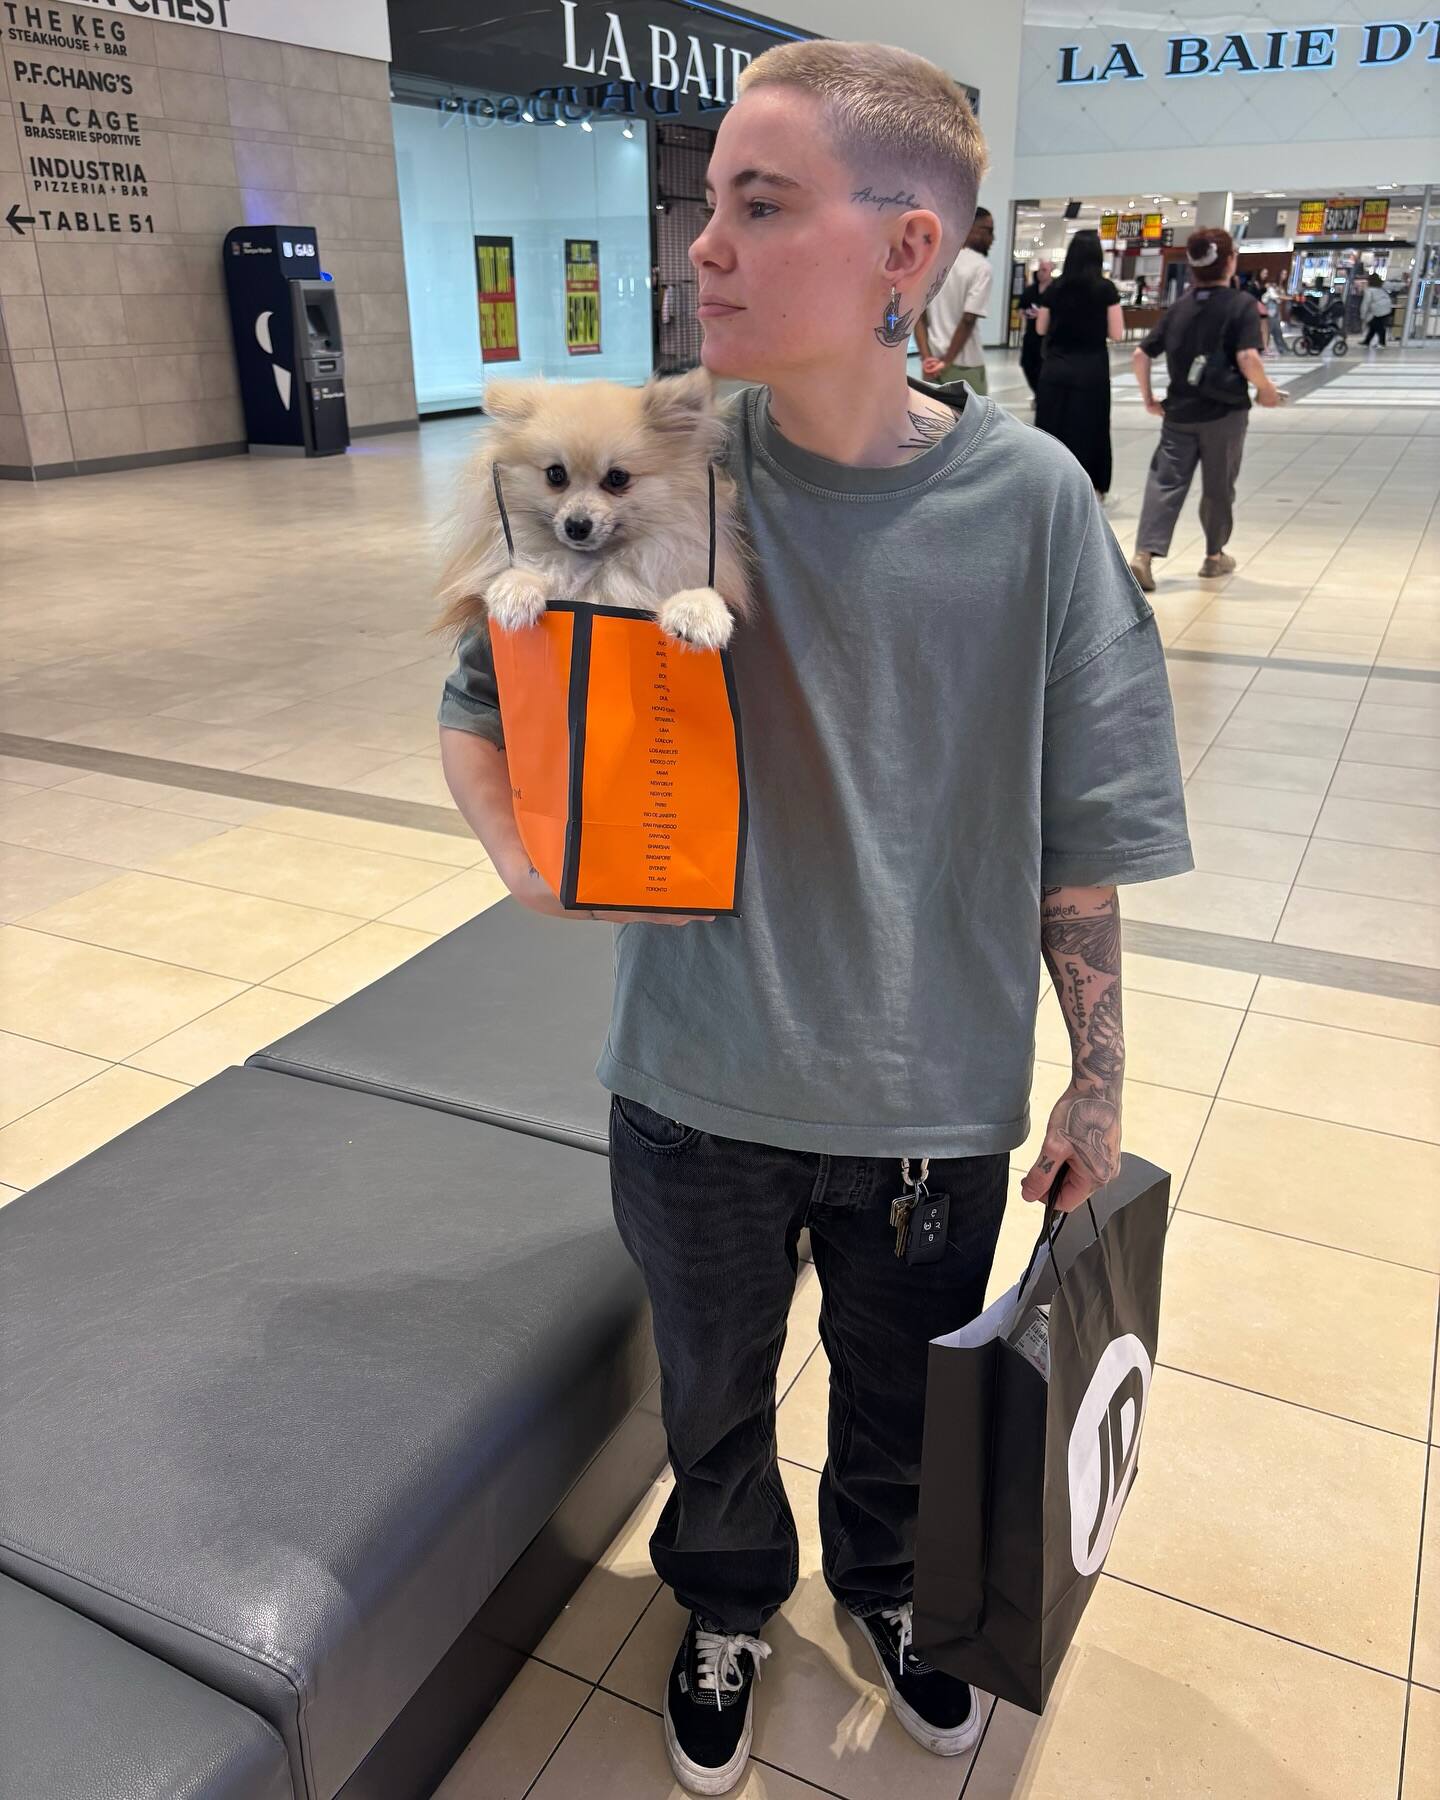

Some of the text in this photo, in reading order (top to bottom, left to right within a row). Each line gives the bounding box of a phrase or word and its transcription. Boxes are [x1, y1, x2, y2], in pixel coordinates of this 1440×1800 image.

[4, 2, 126, 42] THE KEG
[8, 28, 90, 51] STEAKHOUSE
[104, 43, 128, 56] BAR
[560, 0, 636, 82] LA
[1057, 20, 1440, 84] LA BAIE D'
[20, 101, 140, 132] LA CAGE
[24, 125, 142, 147] BRASSERIE SPORTIVE
[30, 156, 147, 183] INDUSTRIA
[34, 180, 107, 195] PIZZERIA
[121, 185, 149, 197] BAR
[39, 210, 154, 233] TABLE 51
